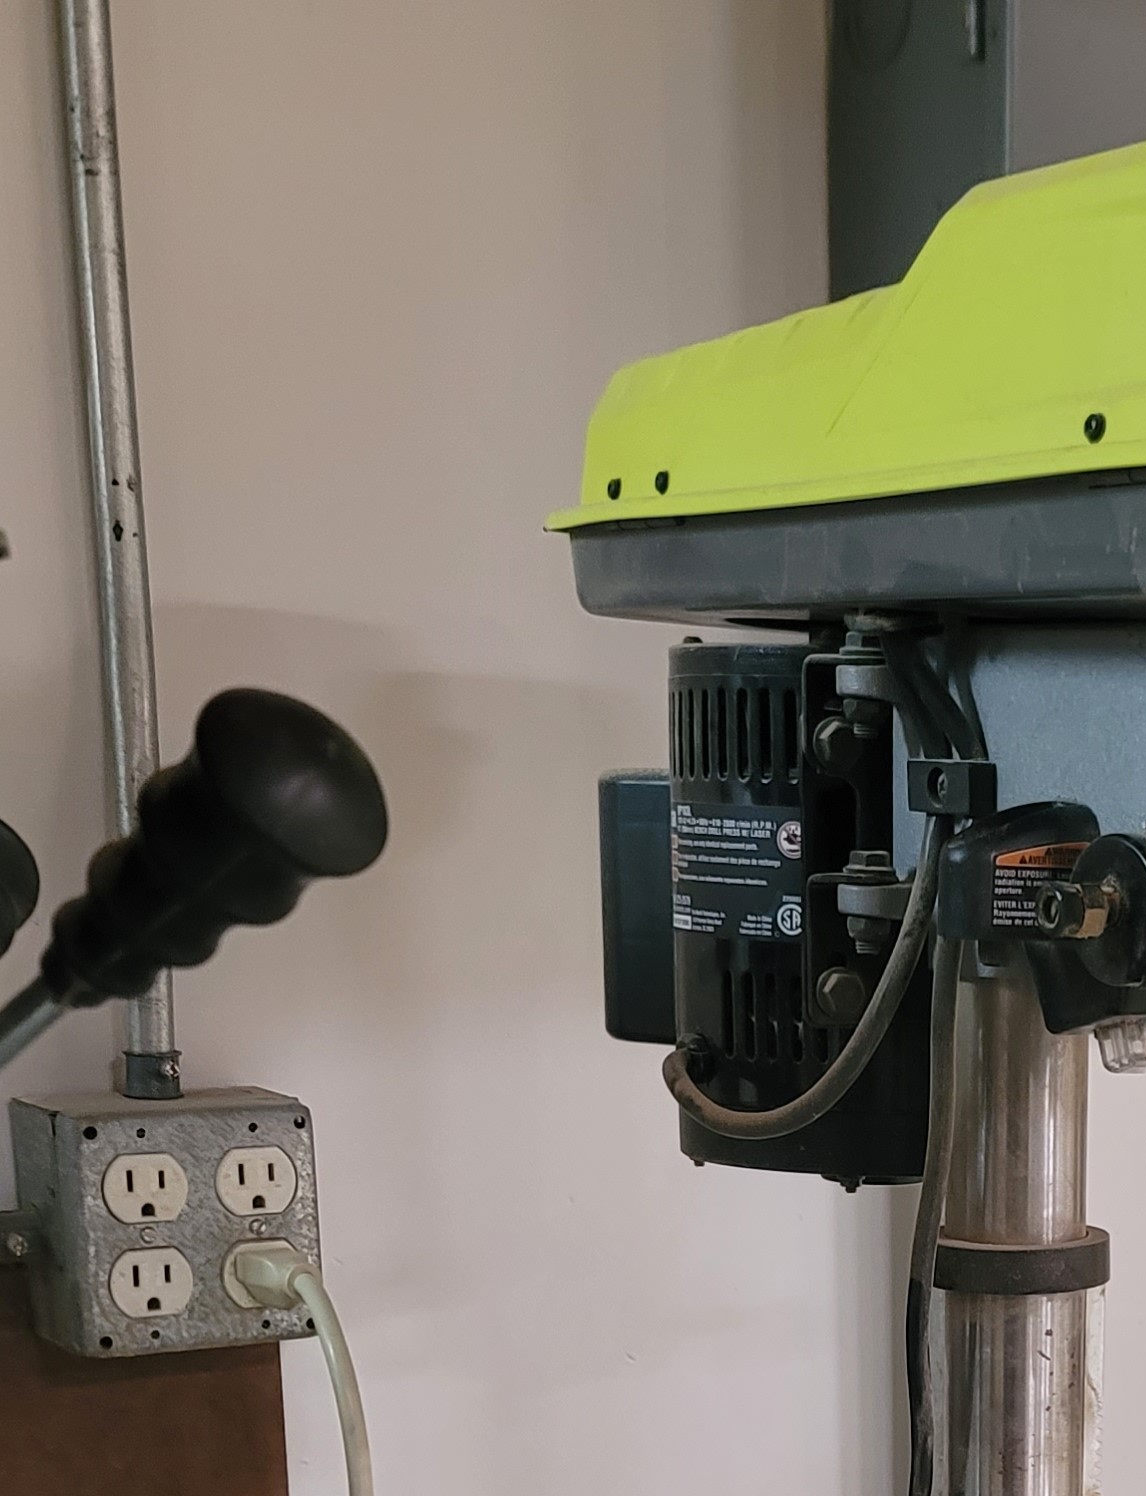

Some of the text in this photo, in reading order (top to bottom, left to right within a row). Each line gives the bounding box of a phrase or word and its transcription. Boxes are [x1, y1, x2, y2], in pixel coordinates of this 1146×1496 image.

[750, 829, 771, 839] LASER
[994, 868, 1016, 878] AVOID
[994, 878, 1025, 886] radiation
[993, 900, 1017, 909] EVITER
